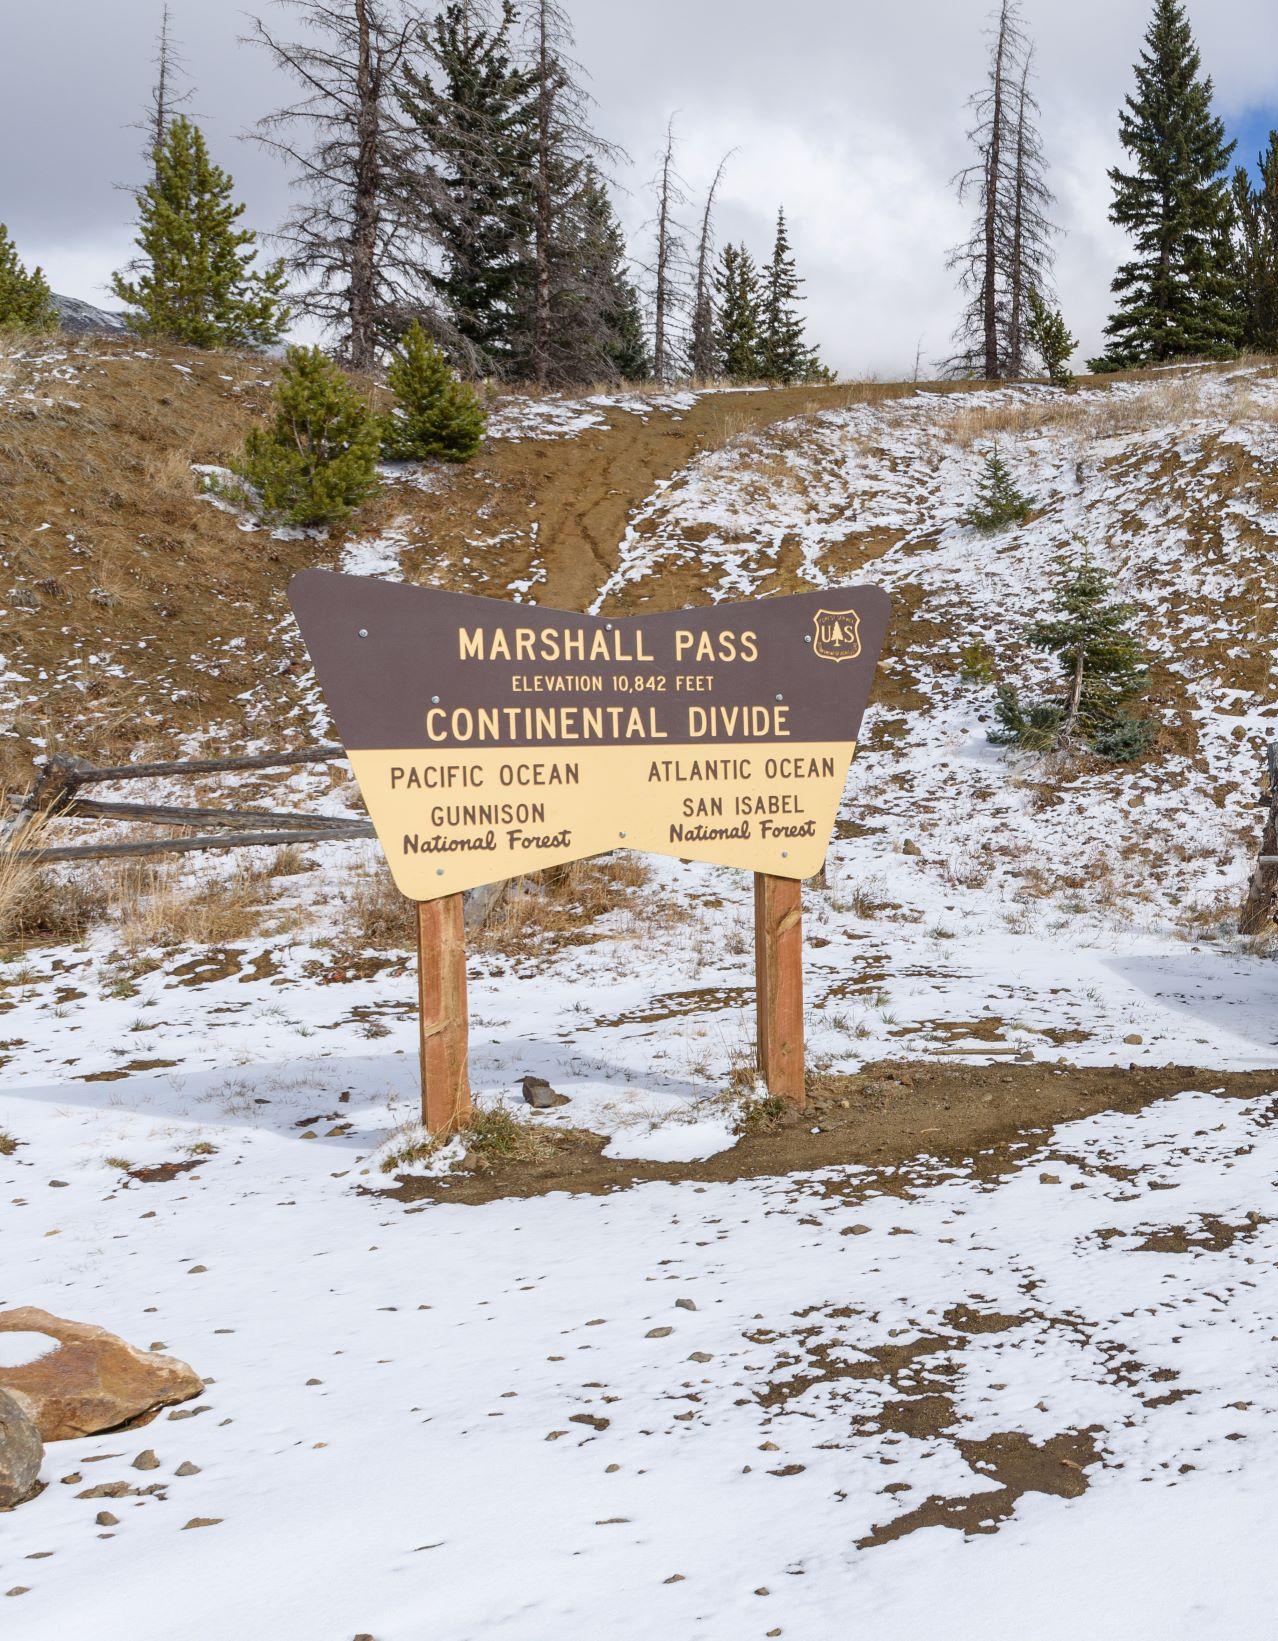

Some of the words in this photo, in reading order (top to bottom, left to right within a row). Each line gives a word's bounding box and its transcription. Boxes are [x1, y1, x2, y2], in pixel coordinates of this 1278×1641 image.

[458, 628, 655, 663] MARSHALL
[675, 630, 758, 663] PASS
[512, 675, 603, 692] ELEVATION
[612, 675, 667, 694] 10,842
[675, 675, 714, 692] FEET
[426, 706, 668, 742] CONTINENTAL
[688, 705, 791, 738] DIVIDE
[390, 765, 484, 790] PACIFIC
[499, 763, 579, 787] OCEAN
[648, 759, 751, 782] ATLANTIC
[764, 757, 835, 779] OCEAN
[431, 802, 545, 827] GUNNISON
[682, 796, 723, 818] SAN
[735, 794, 805, 816] ISABEL
[403, 830, 497, 855] National
[507, 829, 572, 851] Forest
[669, 820, 751, 844] National
[758, 820, 817, 840] Forest
